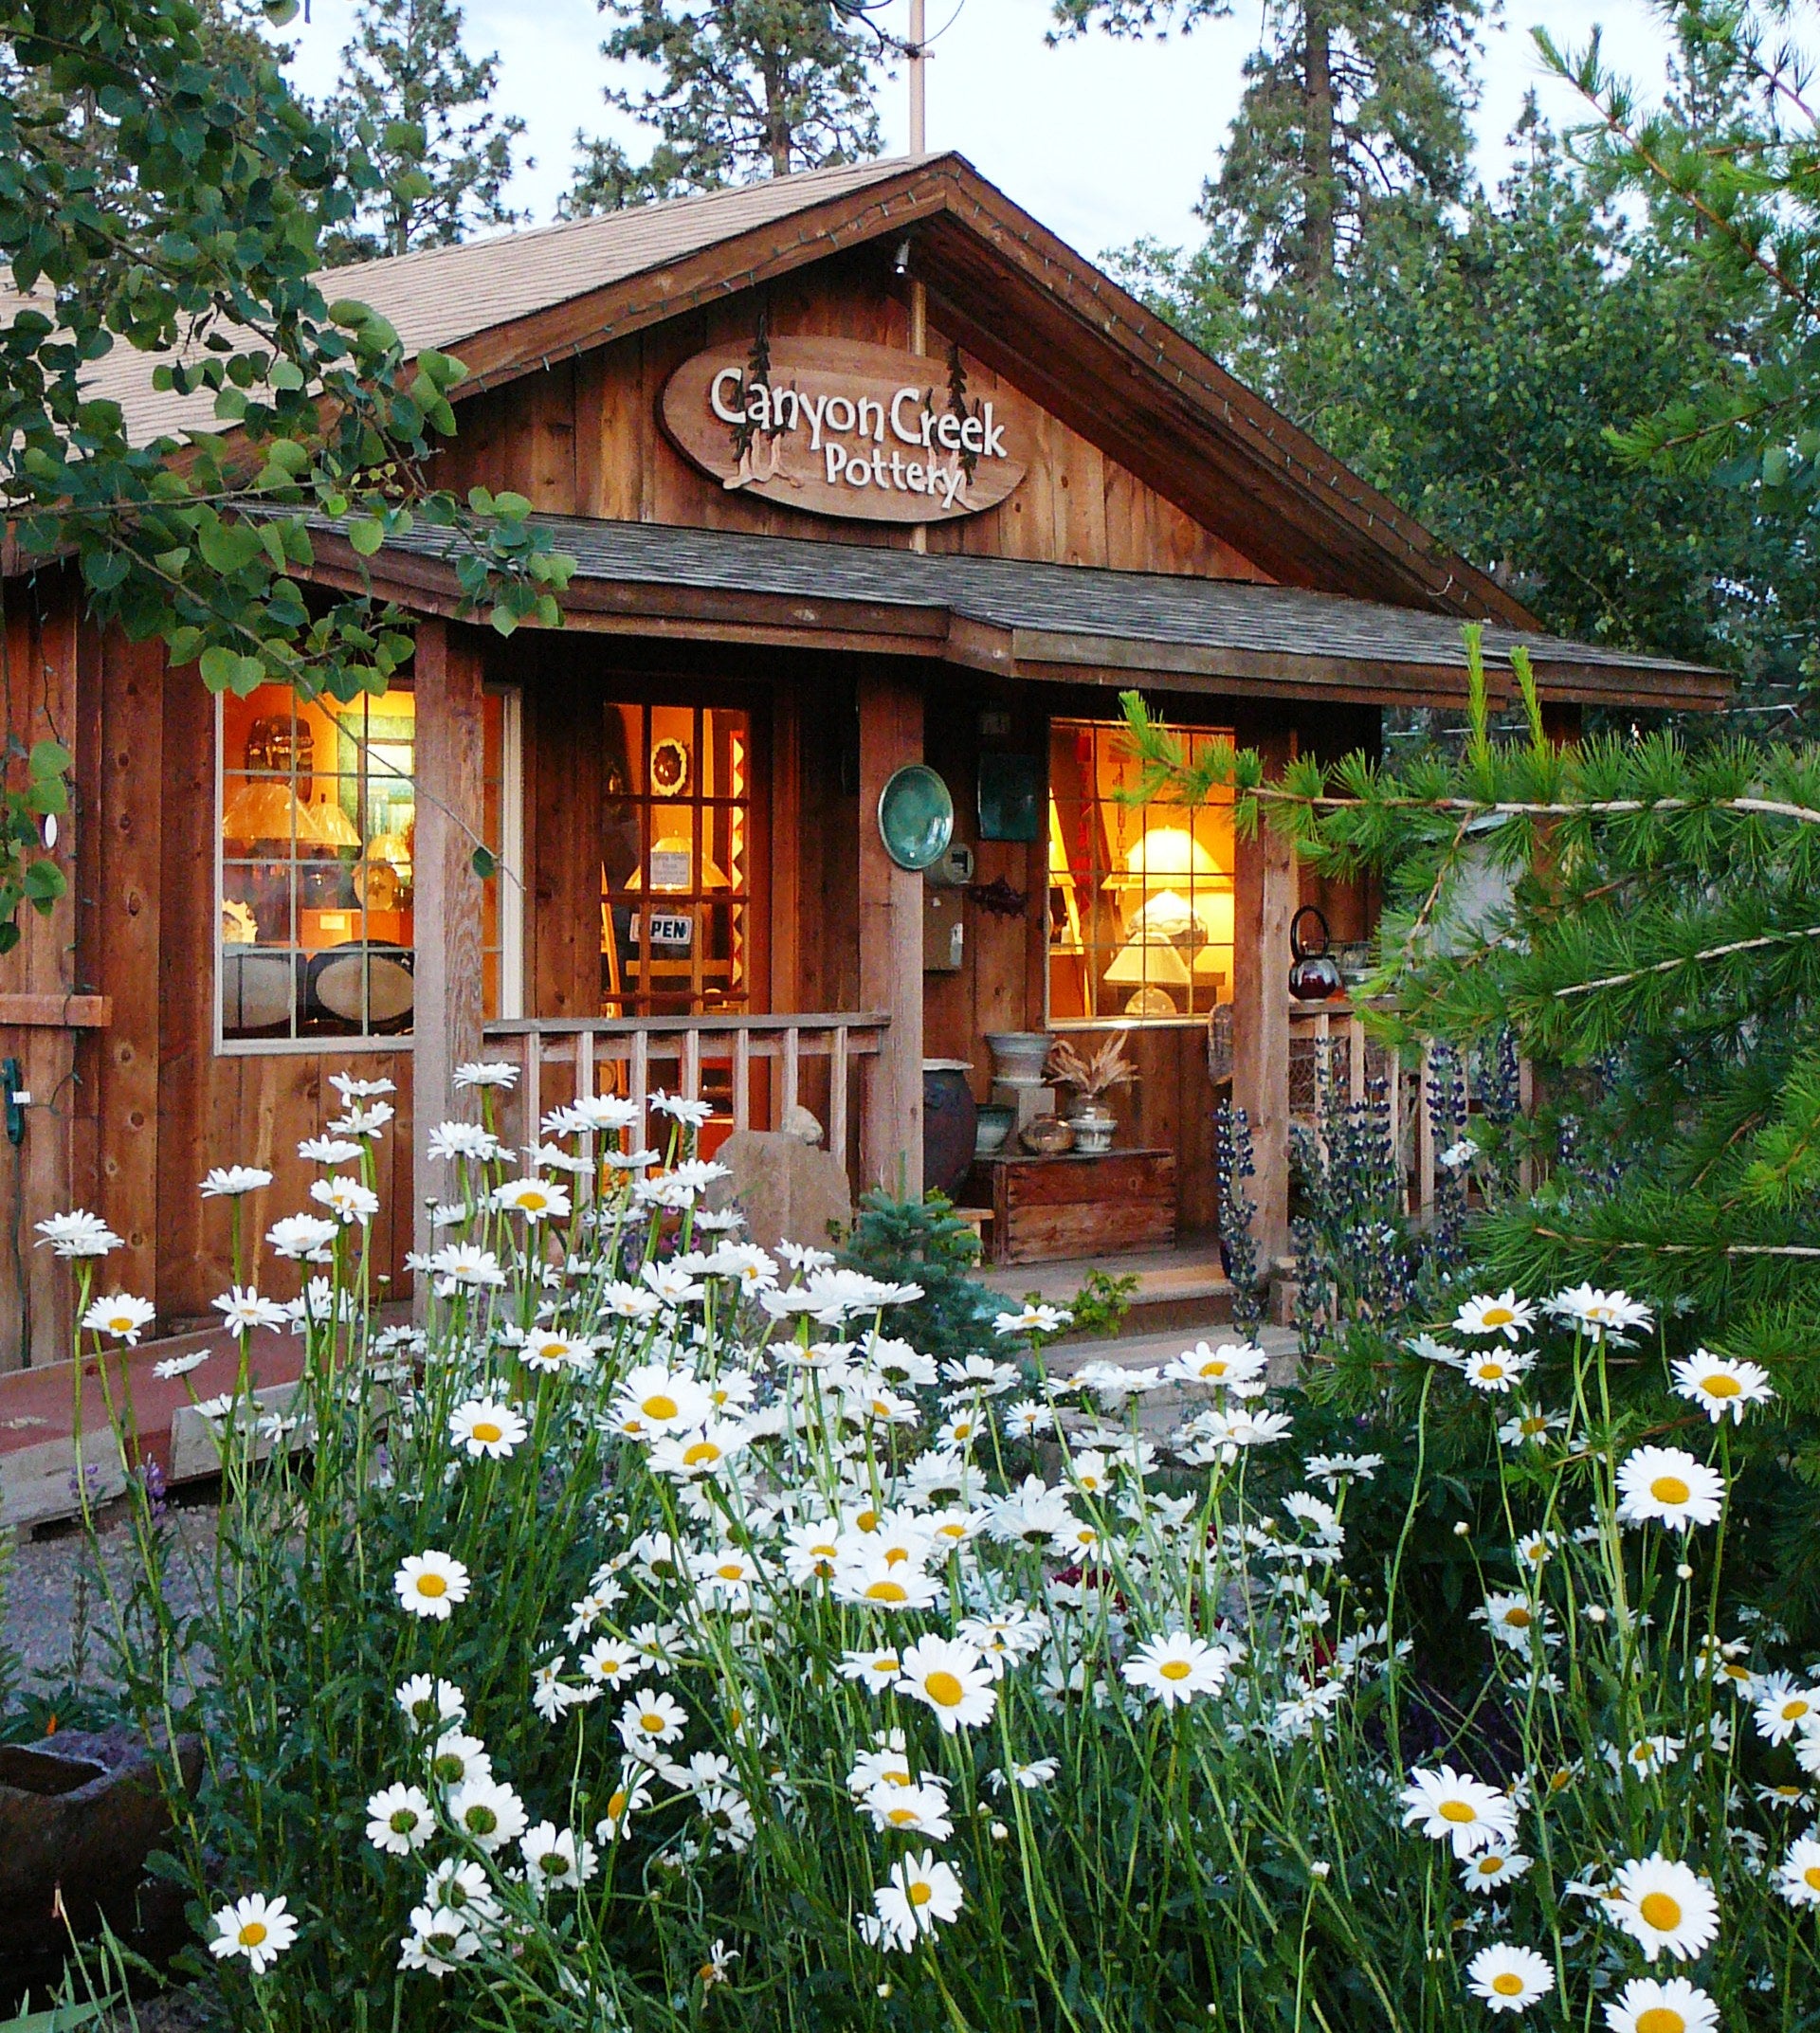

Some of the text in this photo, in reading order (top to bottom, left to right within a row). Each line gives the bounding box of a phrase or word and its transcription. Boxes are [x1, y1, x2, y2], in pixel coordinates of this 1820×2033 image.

[710, 367, 1008, 458] Canyon Creek
[825, 443, 963, 510] Pottery
[639, 920, 687, 938] PEN
